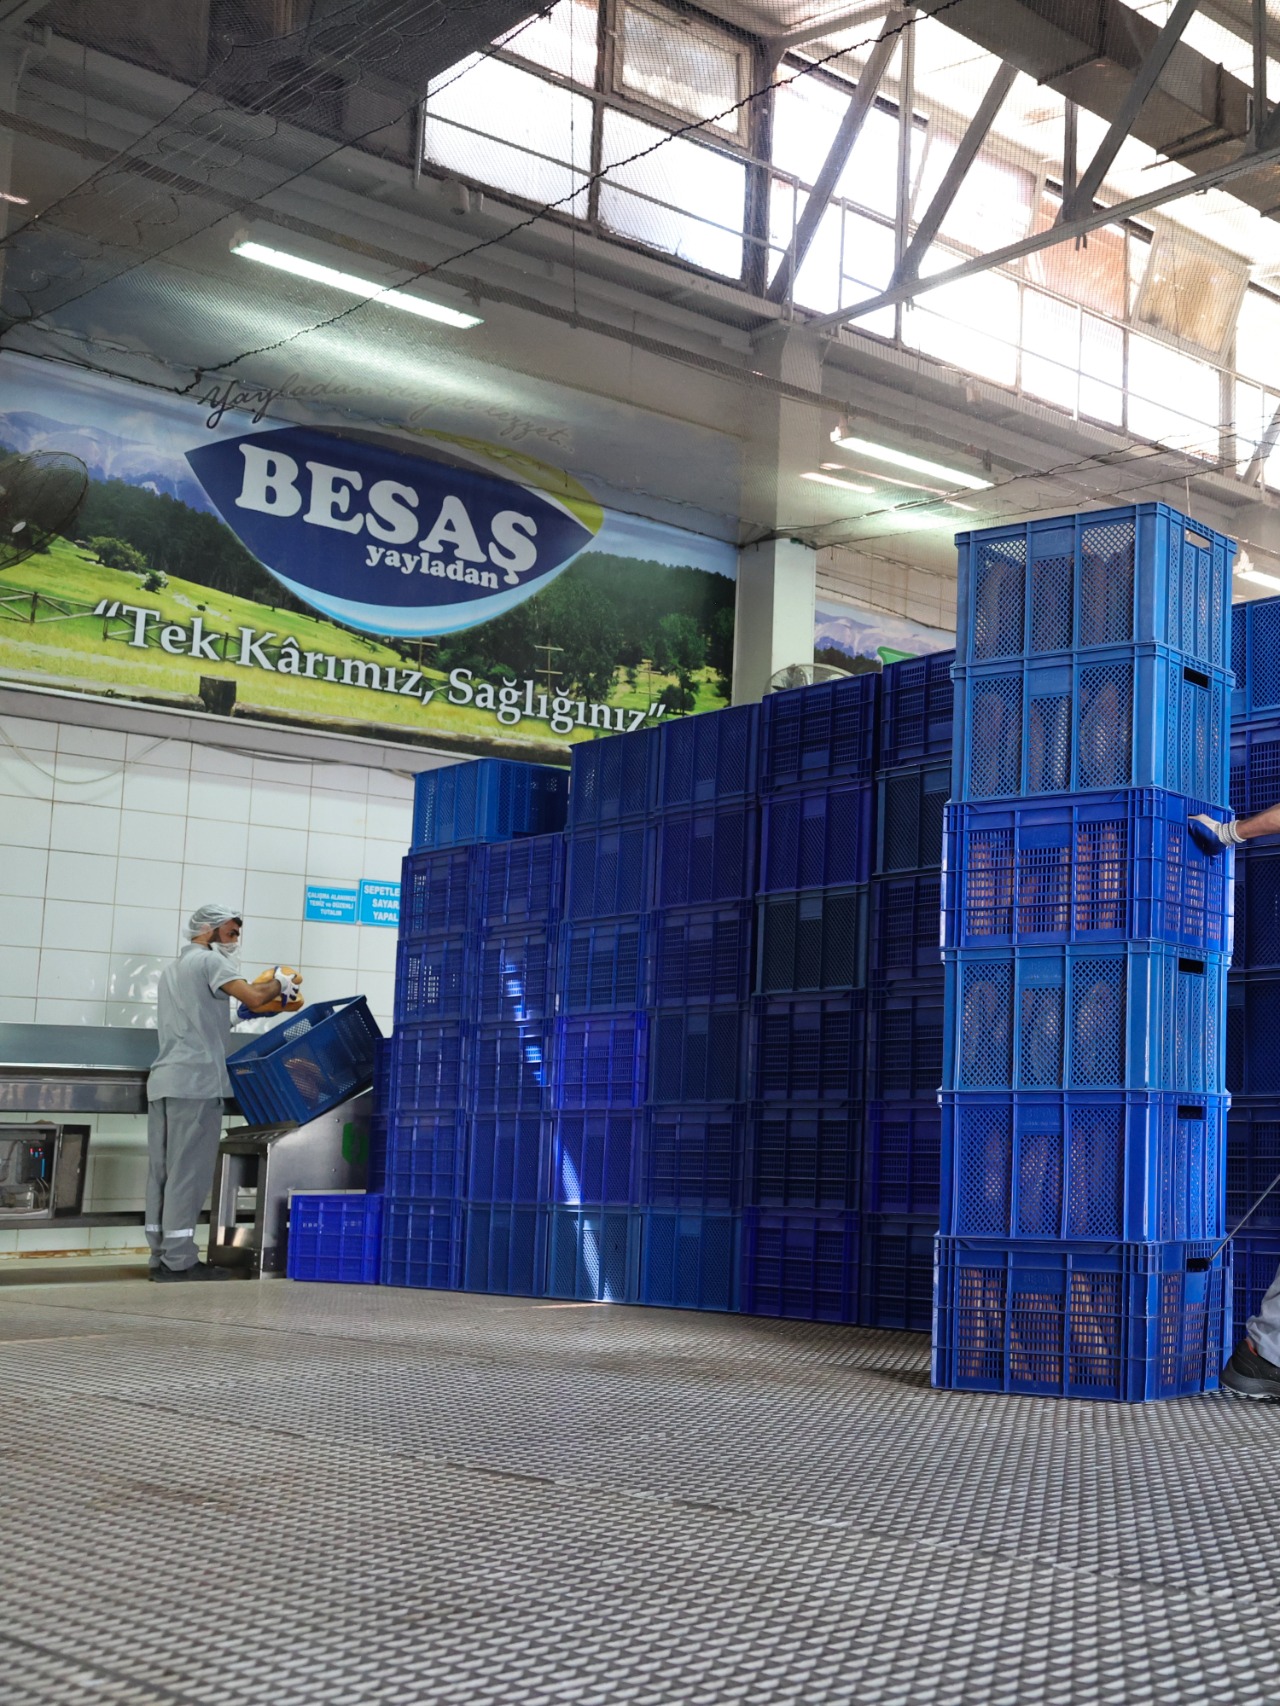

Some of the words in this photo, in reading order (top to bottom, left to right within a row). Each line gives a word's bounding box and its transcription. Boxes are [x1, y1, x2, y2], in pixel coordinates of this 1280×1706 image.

[235, 443, 538, 585] BESAŞ
[365, 544, 499, 590] yayladan
[236, 626, 434, 705] Kârımız,
[364, 885, 400, 897] SEPETLE
[372, 898, 399, 910] SAYAR
[373, 911, 399, 922] YAPAL
